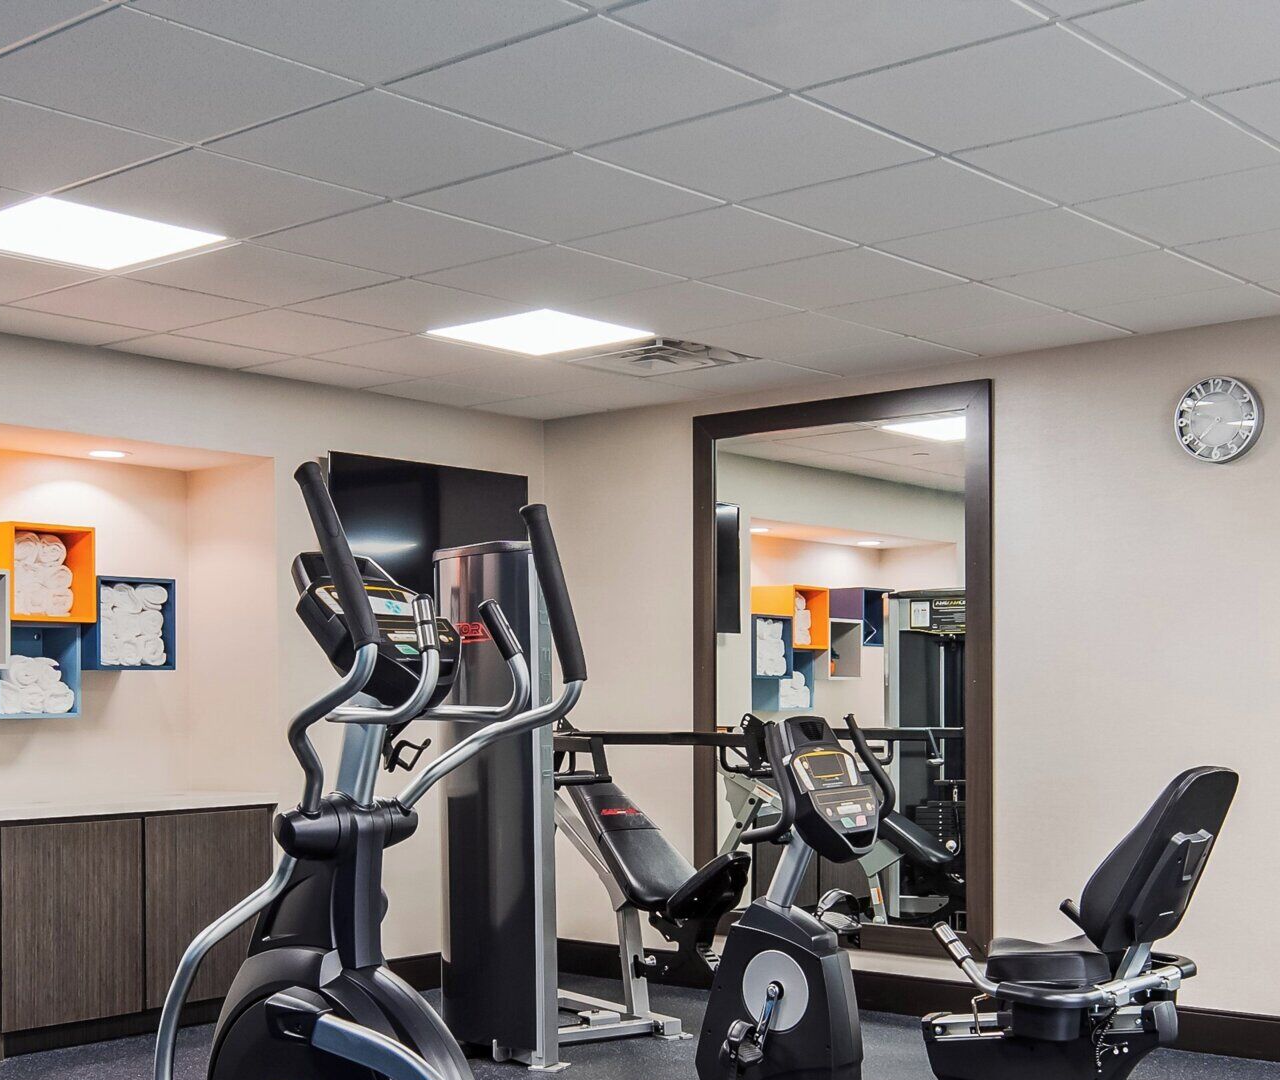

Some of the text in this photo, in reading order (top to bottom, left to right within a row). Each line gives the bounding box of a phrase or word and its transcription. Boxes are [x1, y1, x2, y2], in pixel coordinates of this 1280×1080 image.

[1191, 383, 1207, 400] 11
[1208, 378, 1223, 393] 12
[1182, 433, 1194, 445] 8
[1211, 446, 1221, 460] 6
